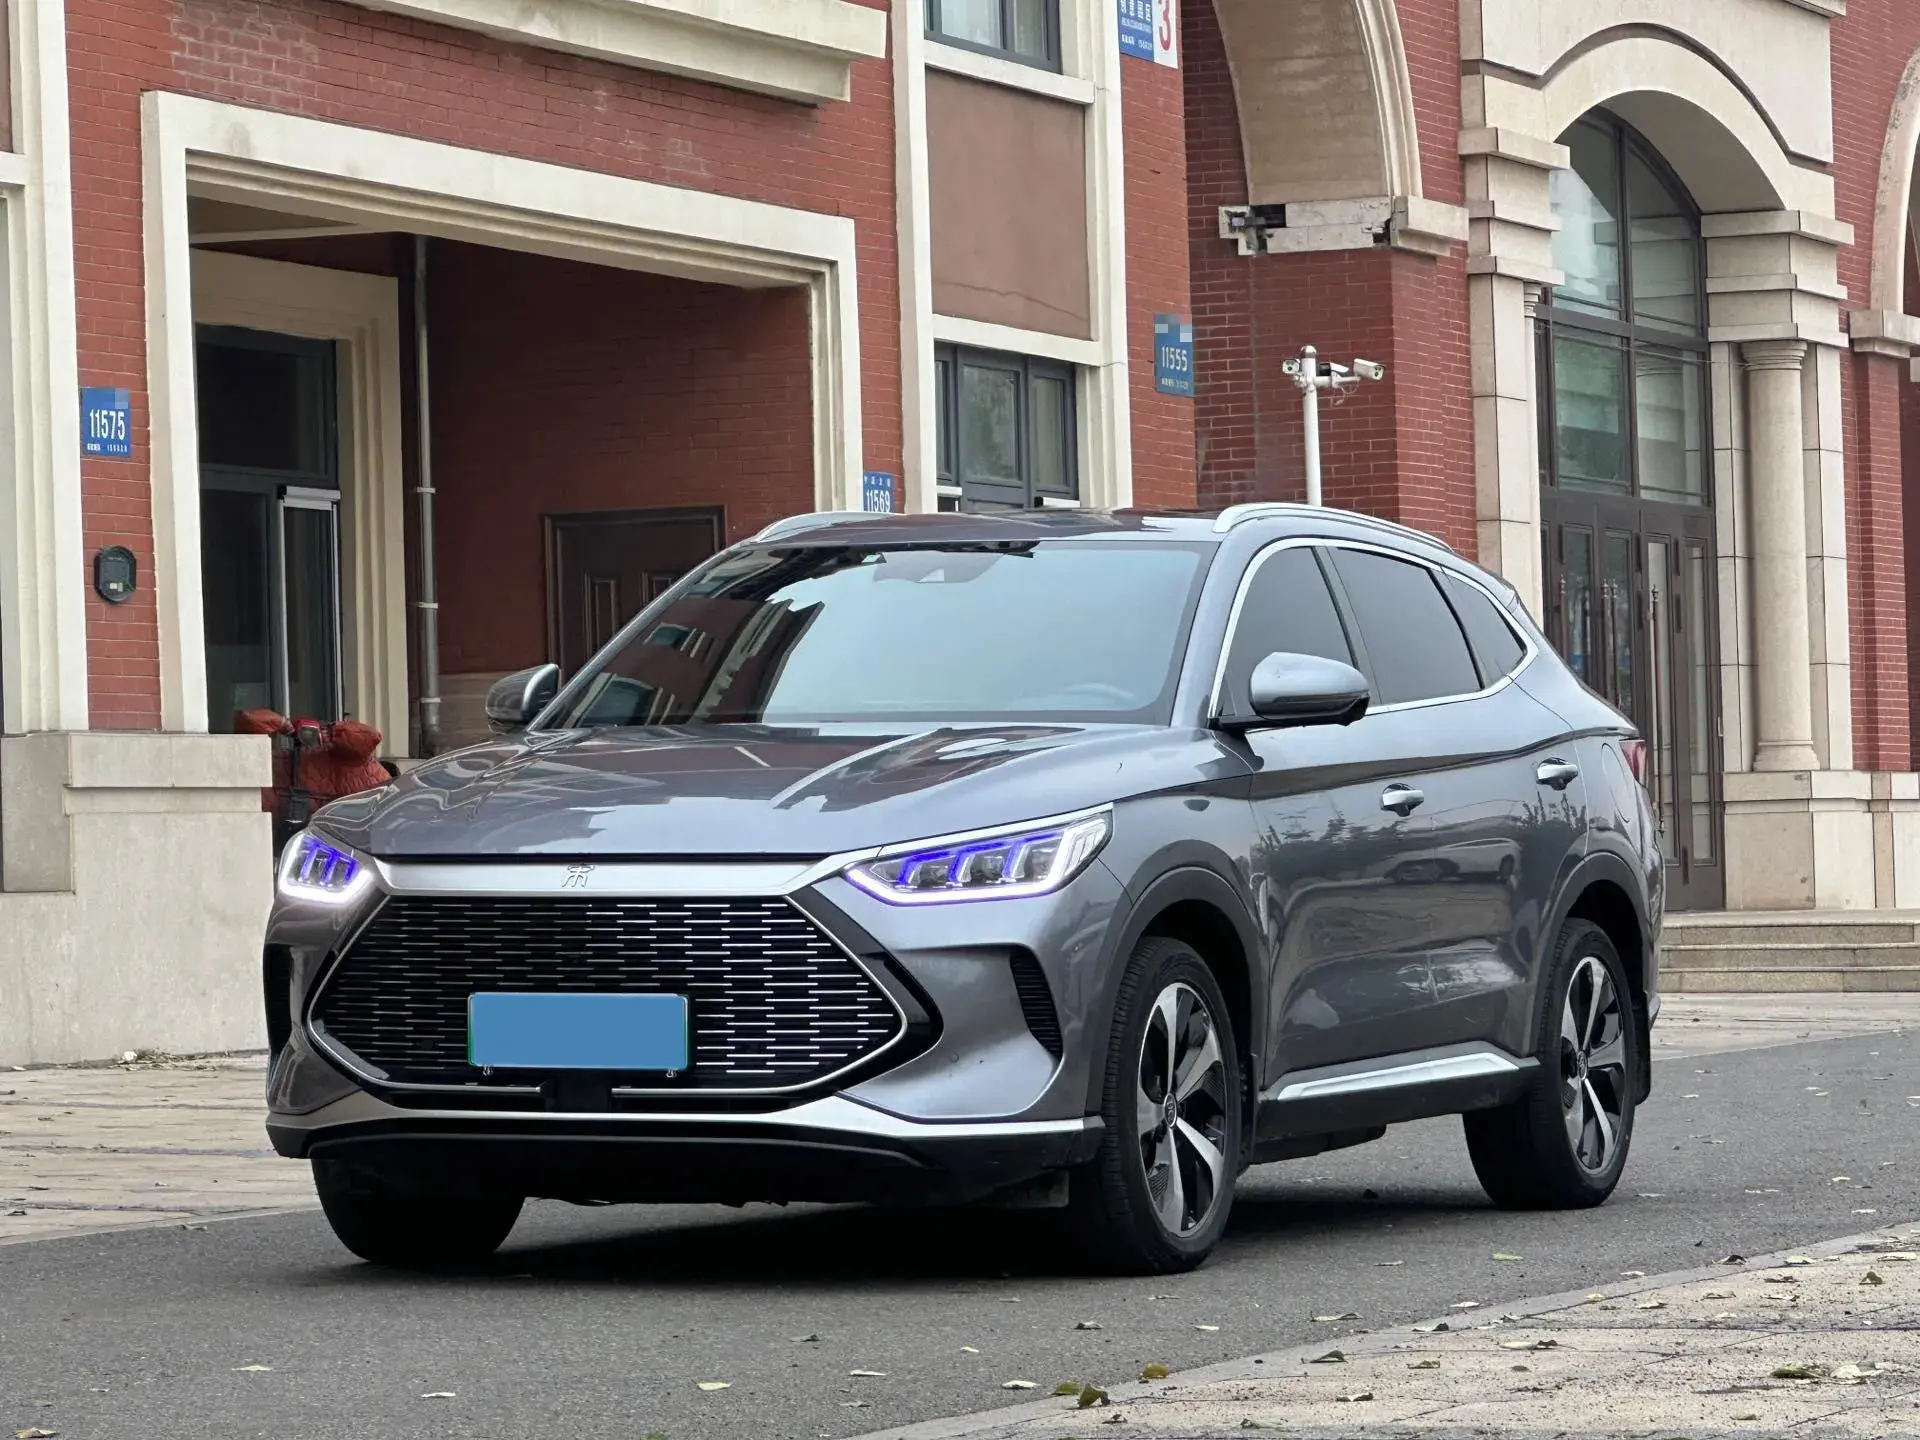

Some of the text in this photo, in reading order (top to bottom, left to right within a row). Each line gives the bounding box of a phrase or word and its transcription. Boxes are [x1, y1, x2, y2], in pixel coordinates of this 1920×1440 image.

[1158, 0, 1171, 51] 3
[1161, 346, 1188, 372] 11555
[90, 409, 126, 440] 11575
[866, 489, 890, 512] 11569
